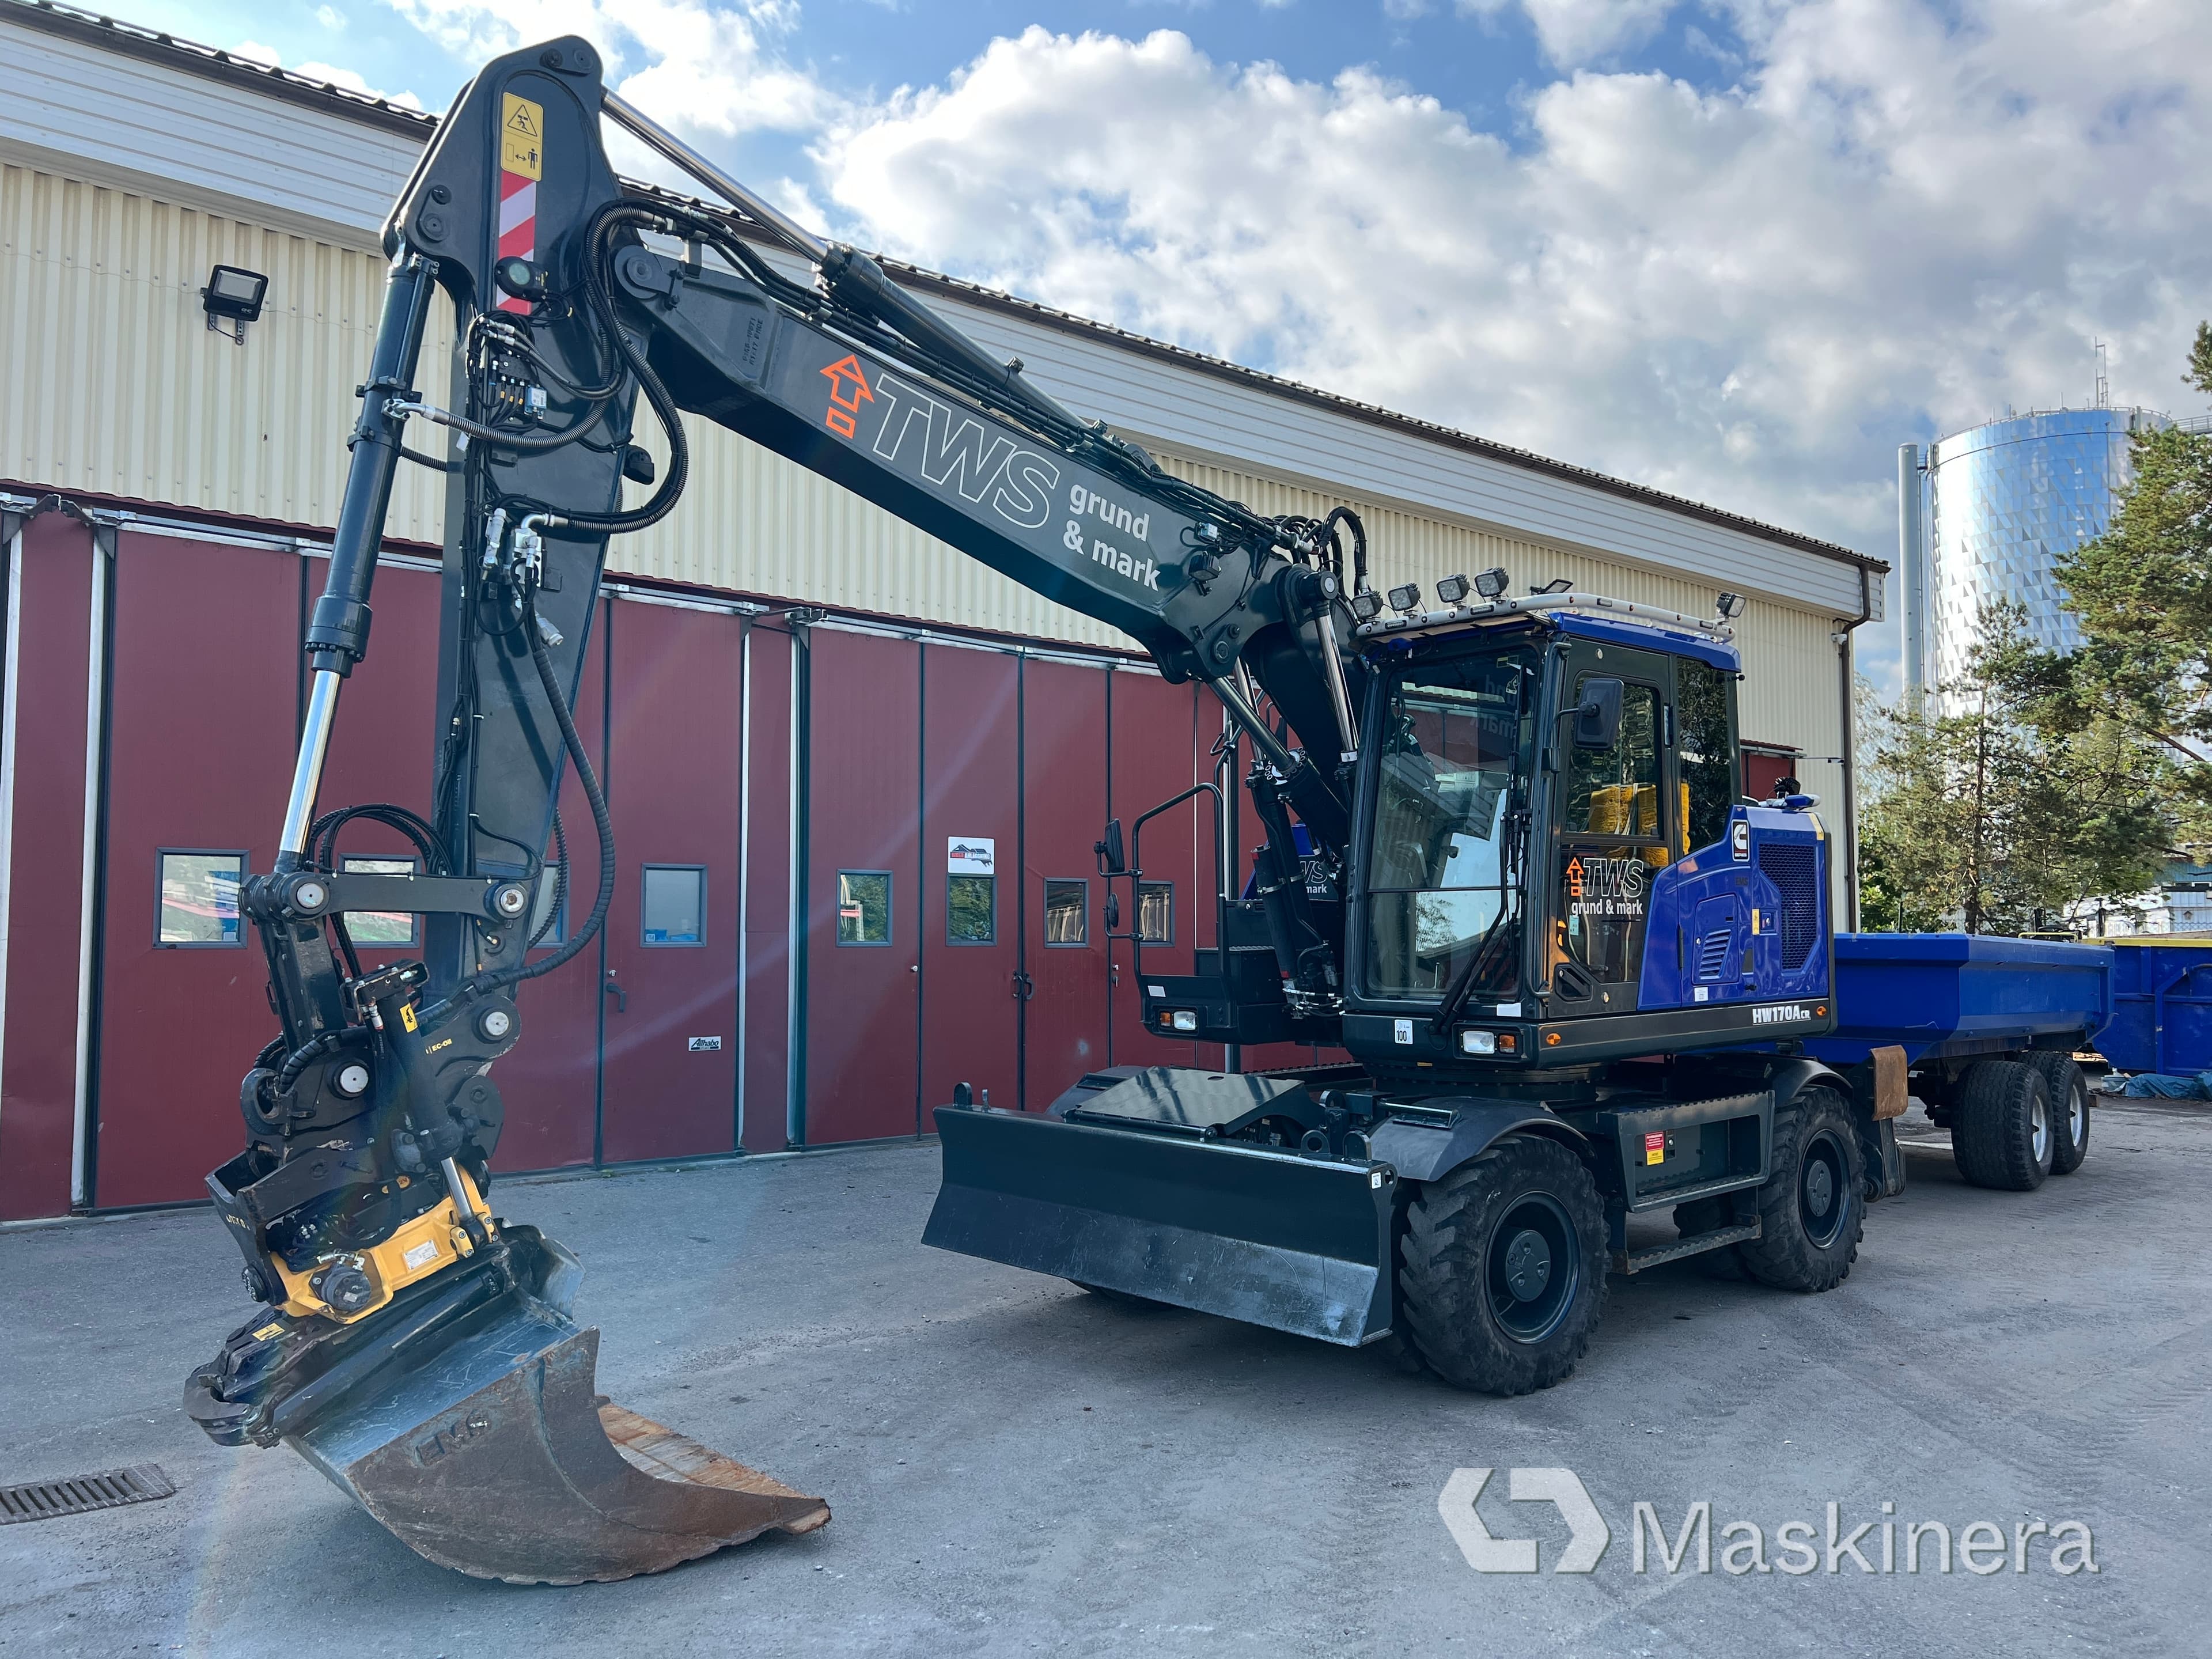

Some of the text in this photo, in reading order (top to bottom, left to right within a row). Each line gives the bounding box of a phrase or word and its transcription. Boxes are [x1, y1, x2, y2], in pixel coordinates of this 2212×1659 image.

[872, 373, 1060, 528] TWS
[1069, 484, 1150, 543] grund
[1063, 519, 1161, 592] & mark
[1583, 858, 1644, 898] TWS
[1571, 899, 1643, 918] grund & mark
[1397, 1030, 1407, 1041] 100
